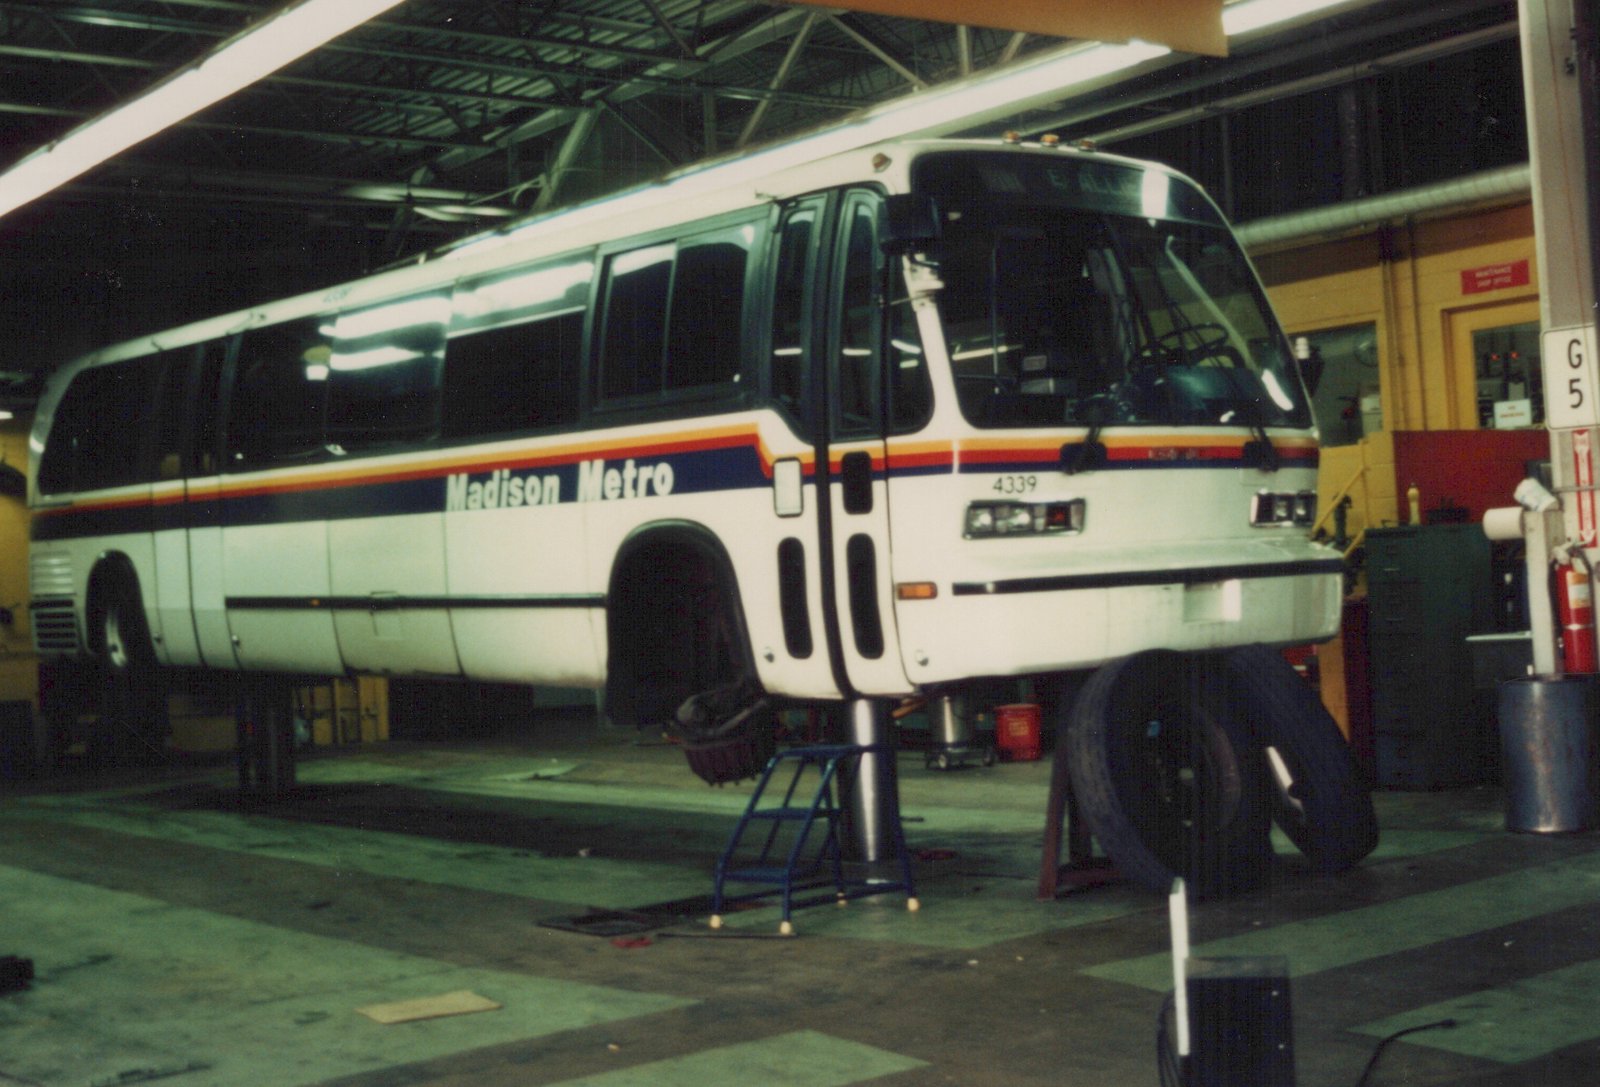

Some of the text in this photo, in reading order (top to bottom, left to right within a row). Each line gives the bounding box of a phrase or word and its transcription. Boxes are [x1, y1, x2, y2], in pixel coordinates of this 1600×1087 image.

[1568, 338, 1582, 369] G
[1569, 378, 1583, 409] 5
[446, 458, 674, 512] Madison Metro
[993, 475, 1037, 494] 4339
